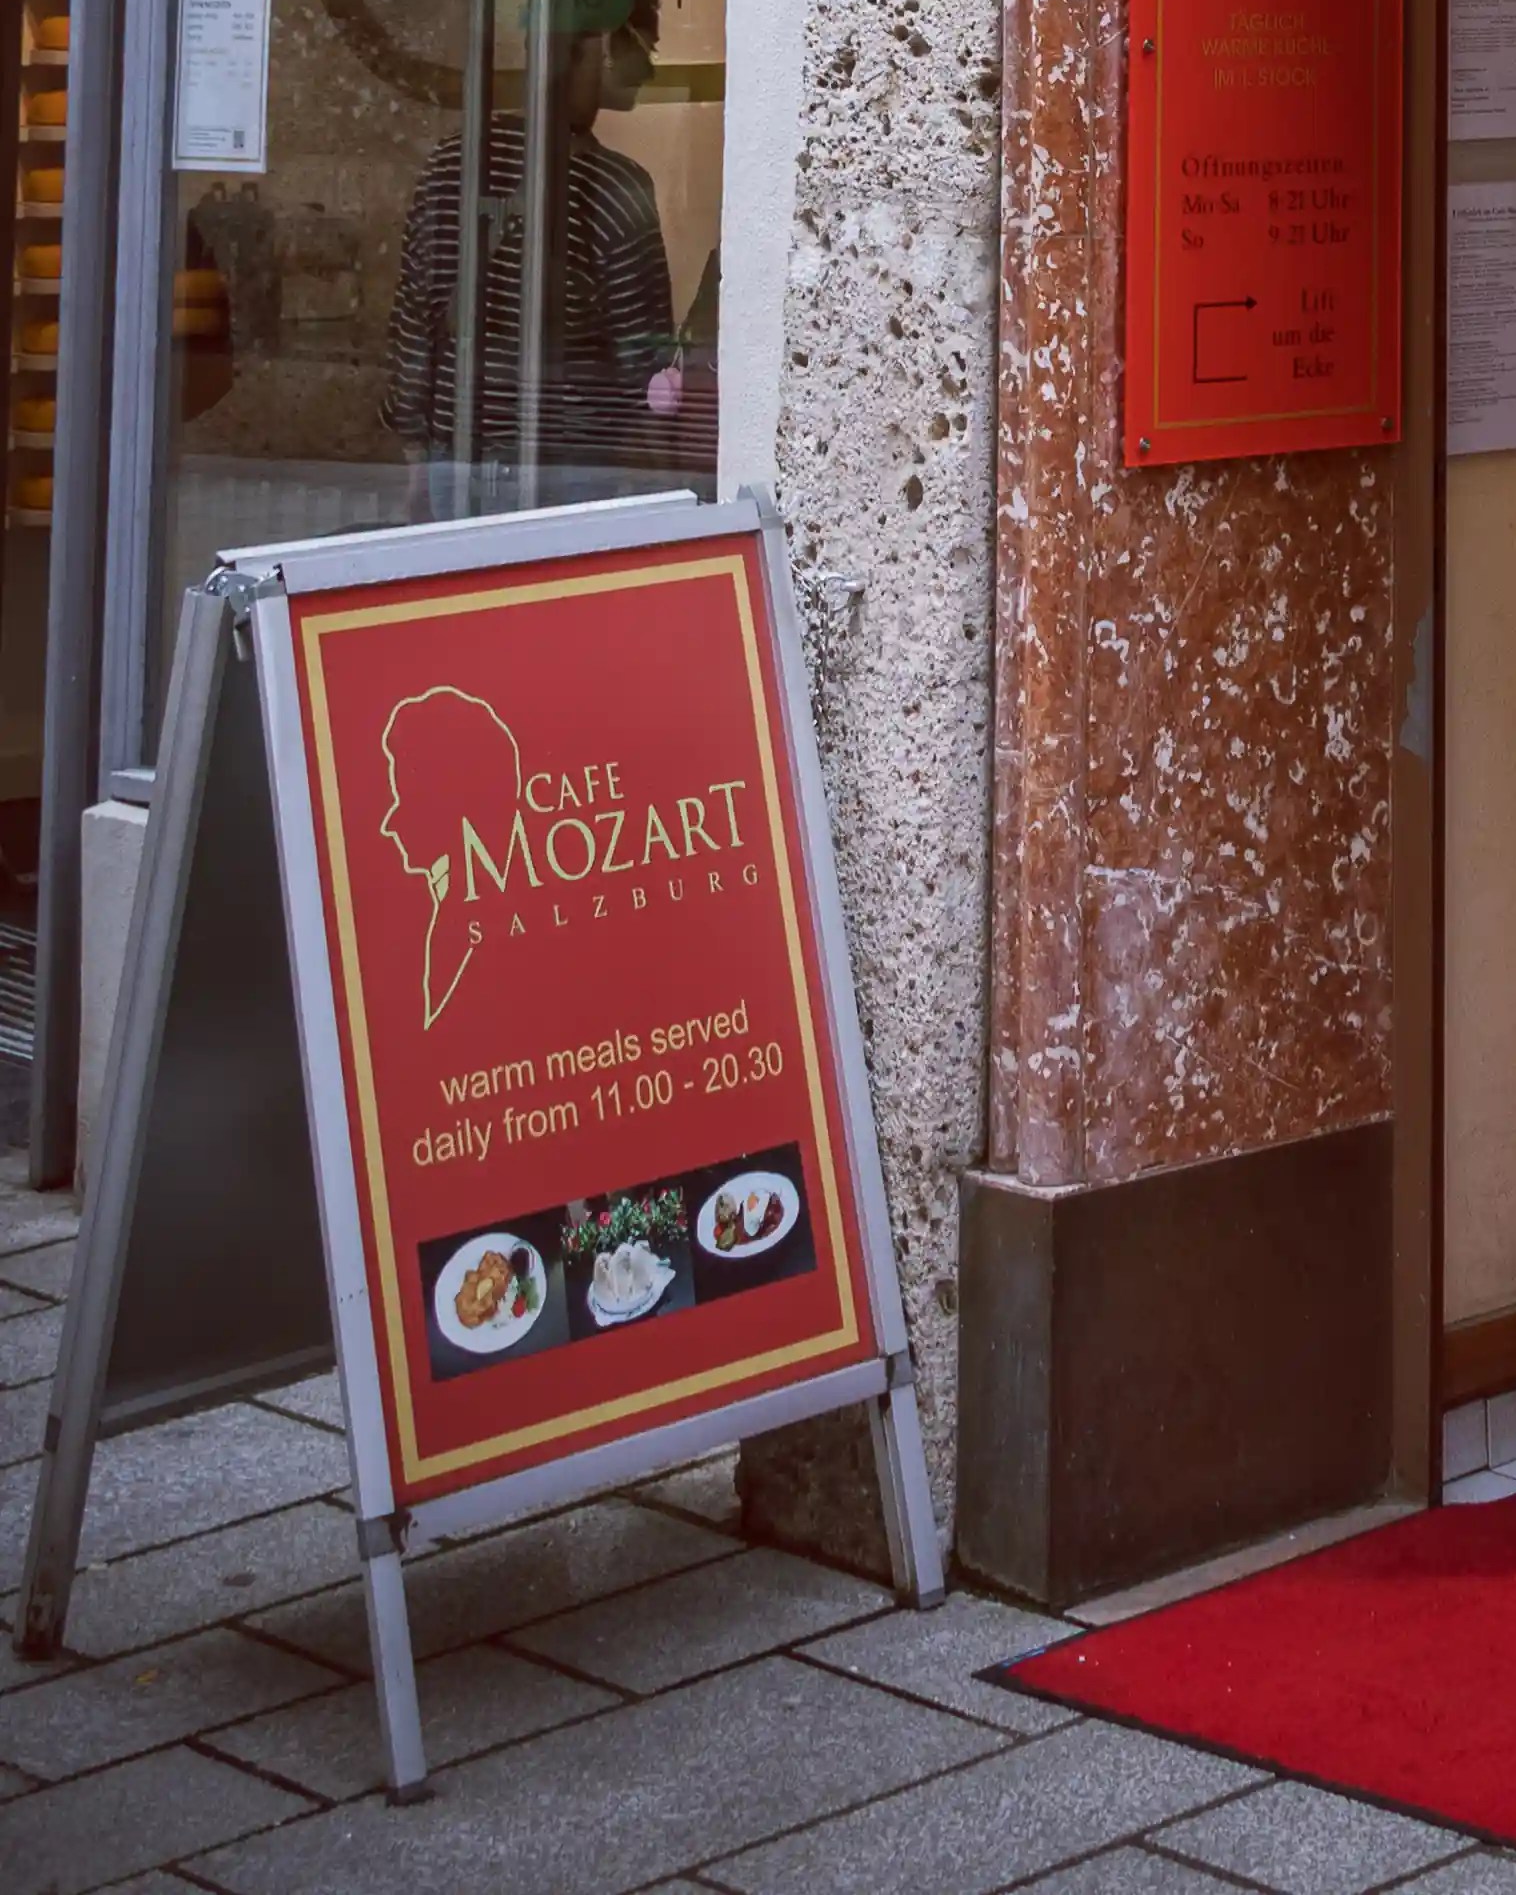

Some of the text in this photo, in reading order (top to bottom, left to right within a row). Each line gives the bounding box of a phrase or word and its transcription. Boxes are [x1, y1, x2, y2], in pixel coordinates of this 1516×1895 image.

[461, 780, 746, 902] MOZART
[525, 761, 625, 814] CAFE
[468, 863, 759, 945] SALZBURG
[412, 1118, 494, 1167] daily
[502, 1100, 579, 1145] from
[589, 1069, 674, 1122] 11.00
[702, 1040, 784, 1094] 20.30
[439, 998, 750, 1105] warm meals served
